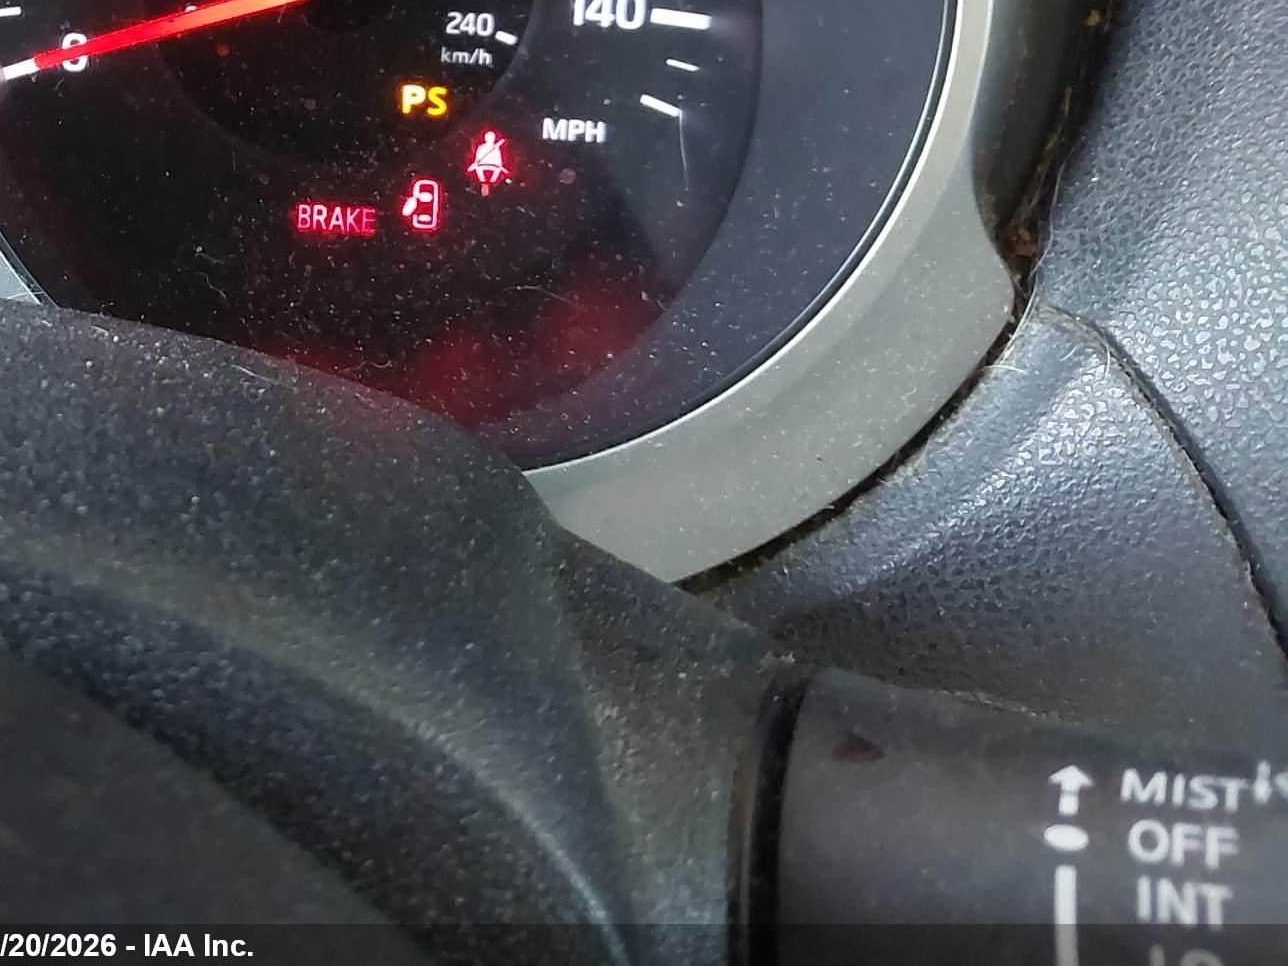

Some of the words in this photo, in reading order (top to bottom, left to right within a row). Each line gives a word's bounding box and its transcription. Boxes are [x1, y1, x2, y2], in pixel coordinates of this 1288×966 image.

[446, 12, 494, 36] 240
[441, 47, 493, 68] km/h
[401, 84, 448, 116] PS
[542, 117, 606, 143] MPH
[297, 204, 376, 234] BRAKE
[1120, 767, 1248, 813] MIST
[1128, 819, 1240, 870] OFF
[1137, 875, 1233, 931] INT
